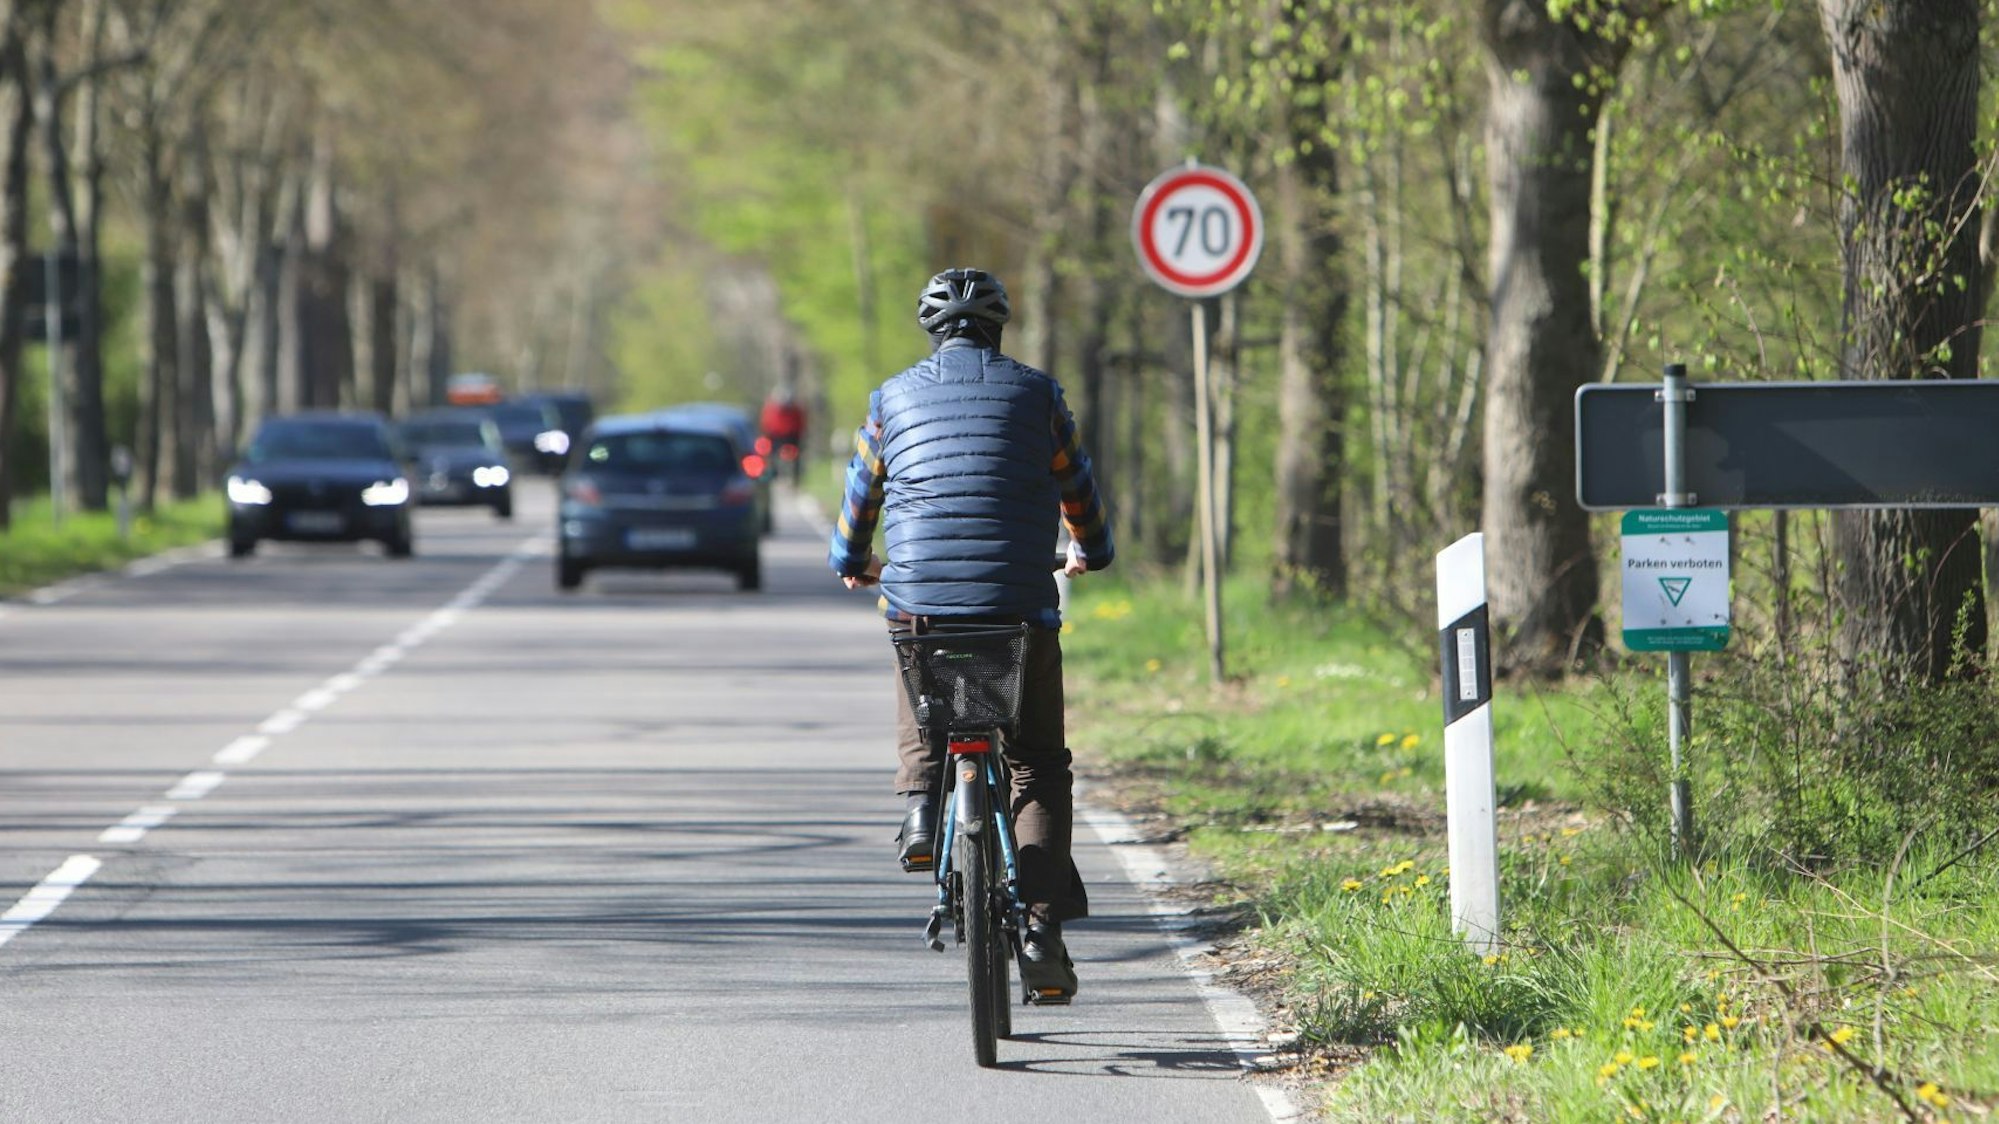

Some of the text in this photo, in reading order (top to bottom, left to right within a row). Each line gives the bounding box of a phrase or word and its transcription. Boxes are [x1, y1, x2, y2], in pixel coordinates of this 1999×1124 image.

[1167, 205, 1231, 257] 70
[1638, 514, 1711, 524] Naturschutzgebiet
[1628, 558, 1722, 569] Parken verboten
